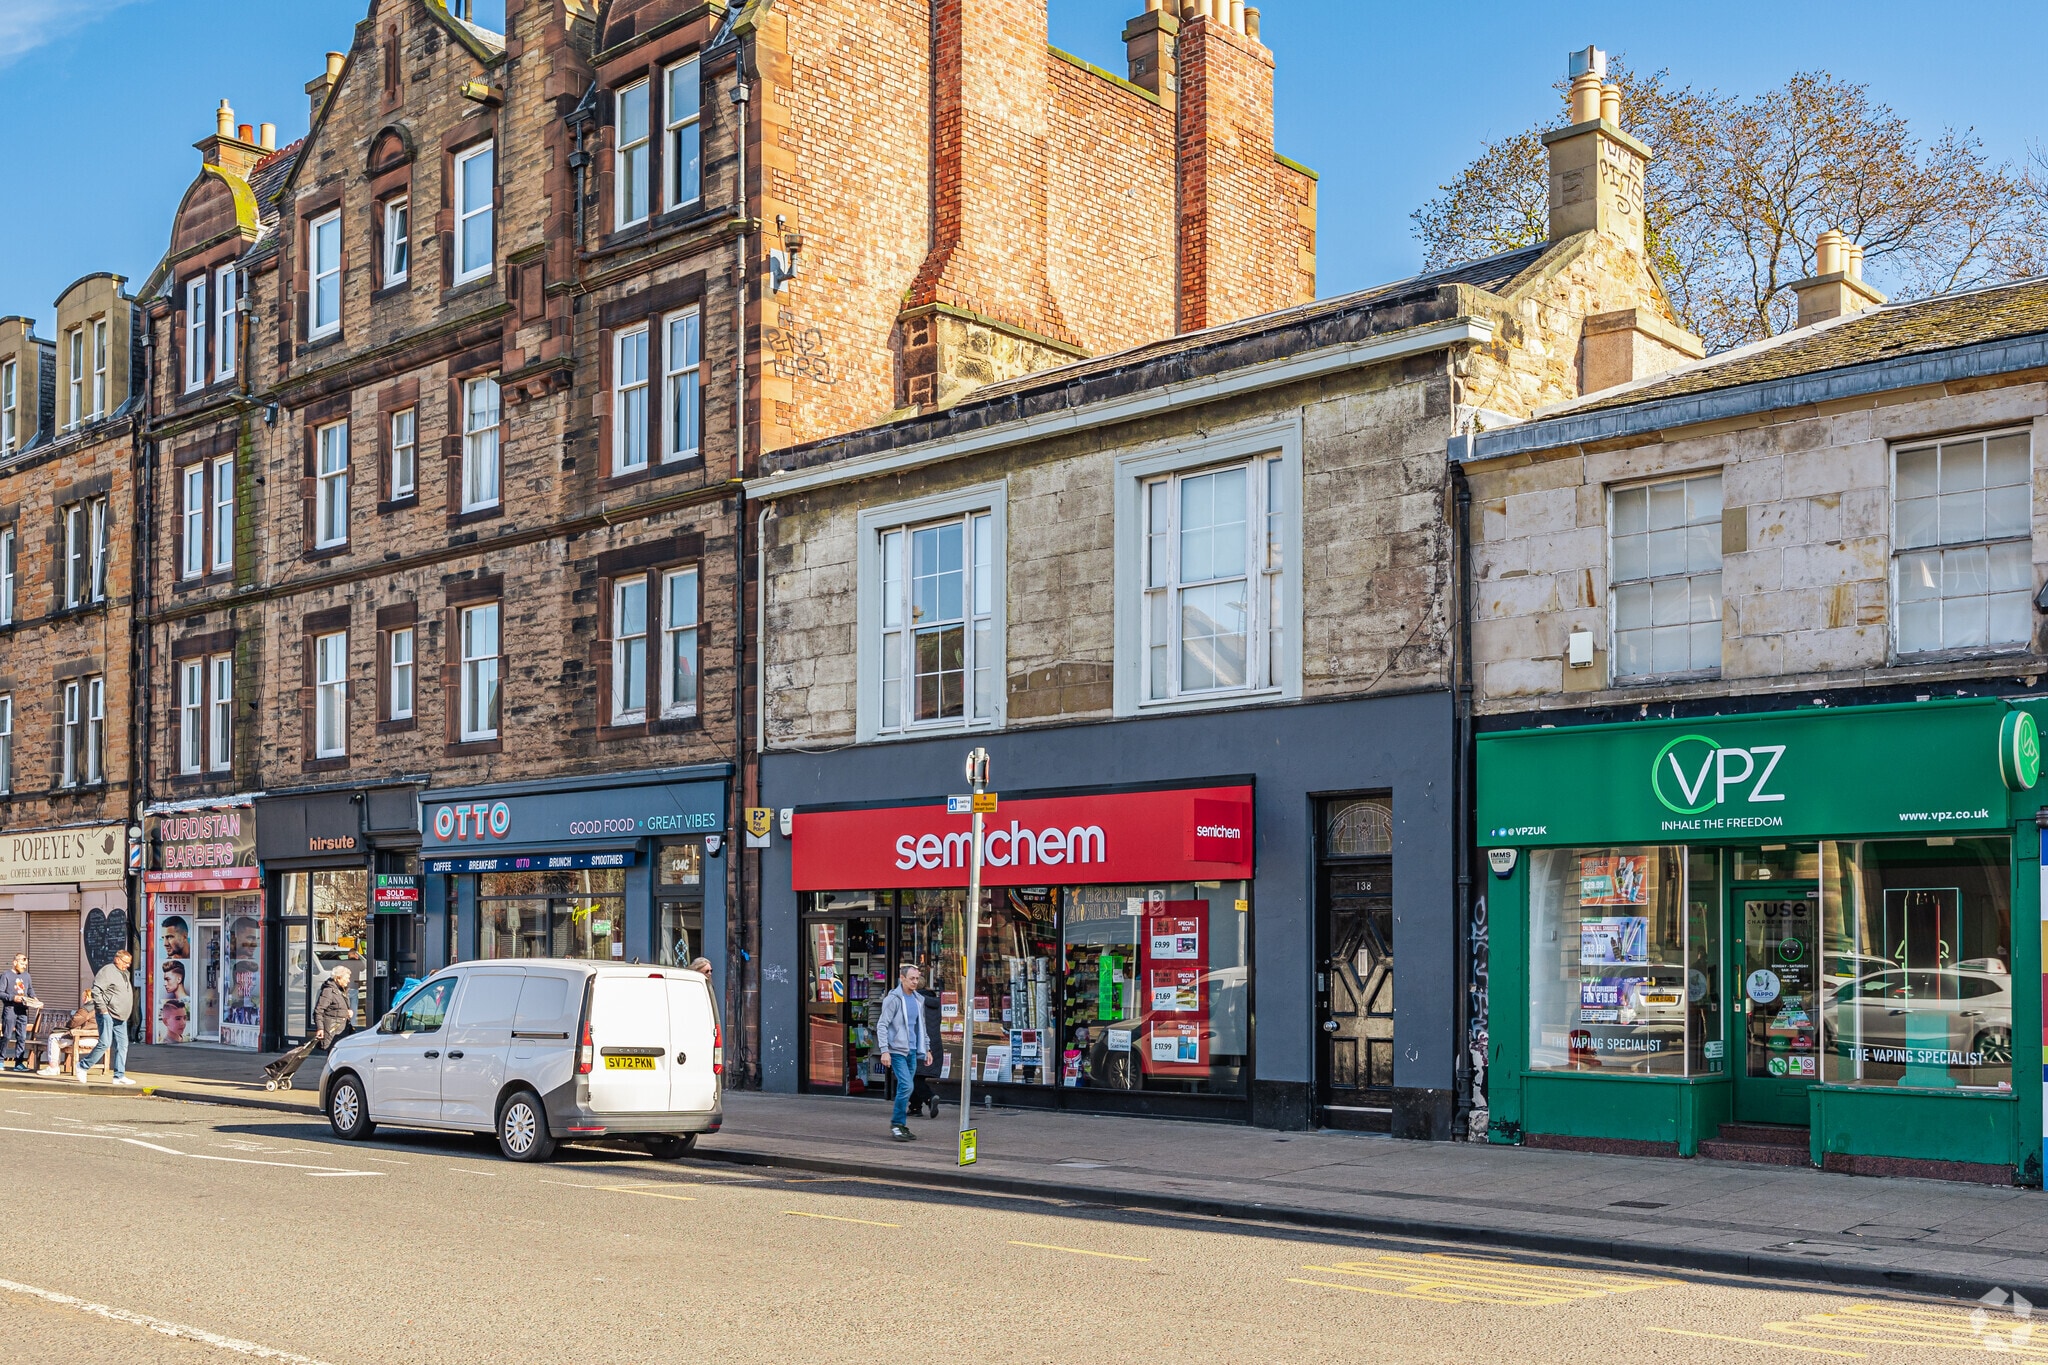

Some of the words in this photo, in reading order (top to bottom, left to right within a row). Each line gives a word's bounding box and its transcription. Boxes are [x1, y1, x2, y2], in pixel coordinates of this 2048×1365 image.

[1668, 745, 1787, 806] VPZ
[434, 802, 510, 841] OTTO
[1899, 808, 1989, 822] www.vpz.co.uk
[160, 813, 241, 841] KURDISTAN
[569, 820, 601, 835] GOOD
[604, 818, 635, 832] FOOD
[647, 814, 683, 830] GREAT
[685, 813, 716, 829] VIBES
[1661, 819, 1701, 831] INHALE
[1703, 818, 1724, 829] THE
[1726, 816, 1783, 828] FREEDOM
[1196, 824, 1241, 839] semichem
[13, 833, 85, 862] POPEYE'S
[309, 835, 355, 851] hirsute
[895, 819, 1106, 870] semichem
[95, 858, 122, 866] TRADITIONAL
[165, 842, 234, 868] BARBERS
[433, 861, 452, 872] COFFEE
[468, 859, 498, 870] BREAKFAST
[515, 858, 530, 868] OTTO
[548, 856, 572, 868] BRUNCH
[591, 854, 623, 866] SMOOTHIES
[671, 859, 689, 872] 134C
[10, 868, 31, 878] COFFEE
[32, 867, 47, 878] SHOP
[48, 867, 52, 877] &
[54, 866, 70, 877] TAKE
[71, 865, 87, 876] AWAY
[95, 867, 108, 875] FRESH
[108, 867, 122, 875] CAKES
[387, 876, 414, 885] ANNAN
[1356, 881, 1372, 891] 138
[159, 895, 191, 904] TURKISH
[386, 889, 404, 897] SOLD
[164, 904, 187, 912] STYLE
[1154, 941, 1170, 949] £9.99
[1155, 992, 1171, 1000] £1.69
[1552, 1036, 1567, 1048] THE
[1570, 1037, 1604, 1050] VAPING
[1607, 1038, 1662, 1052] SPECIALIST
[608, 1057, 634, 1068] SV72
[635, 1058, 653, 1068] PKN
[1848, 1047, 1869, 1061] THE
[1872, 1049, 1913, 1063] VAPING
[1917, 1051, 1984, 1066] SPECIALIST
